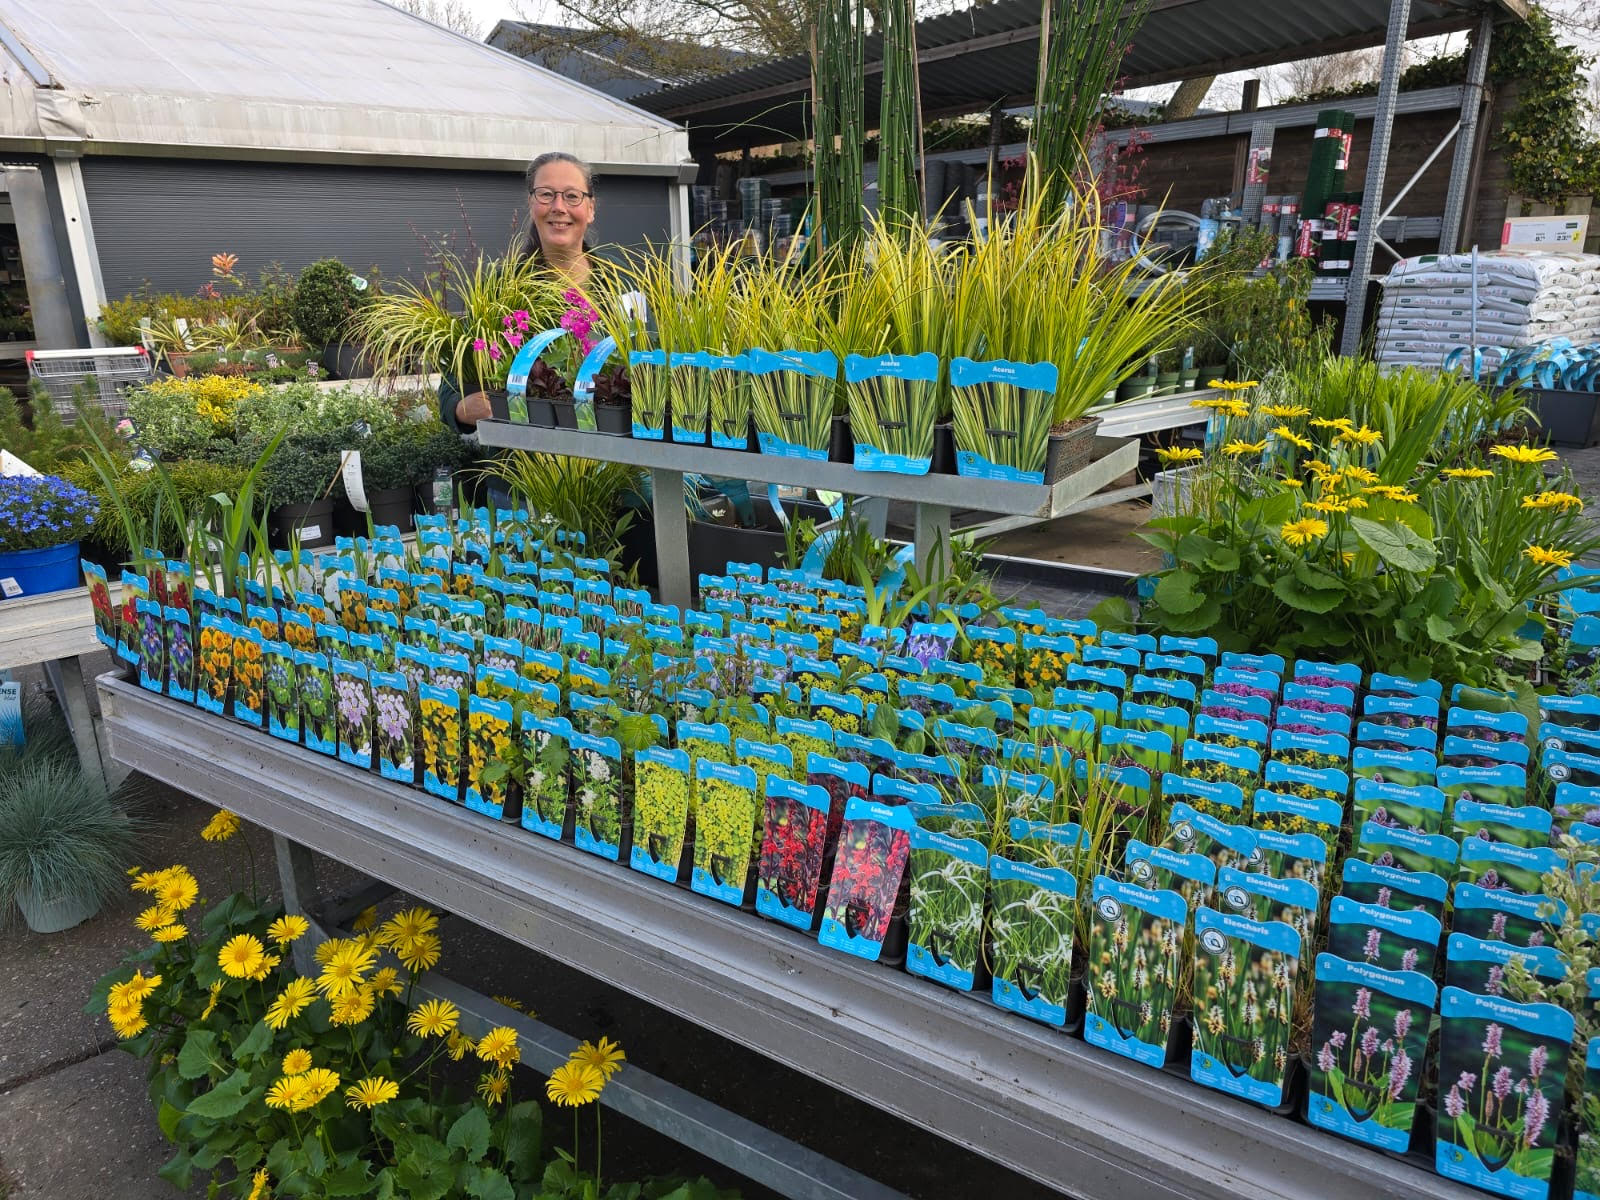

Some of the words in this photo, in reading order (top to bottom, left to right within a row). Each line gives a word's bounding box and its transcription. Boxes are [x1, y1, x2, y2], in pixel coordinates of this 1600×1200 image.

[992, 365, 1016, 374] Acorus
[1213, 720, 1248, 731] Ranunculus
[1291, 735, 1328, 745] Ranunculus
[1383, 729, 1410, 738] Stachys
[1203, 746, 1240, 758] Ranunculus
[1472, 743, 1500, 752] Stachys
[1374, 752, 1414, 762] Pontederia
[712, 765, 740, 776] Lysimachia
[1286, 767, 1328, 780] Ranunculus
[1459, 770, 1501, 778] Pontederia
[787, 784, 808, 796] Lobelia
[896, 783, 918, 794] Lobelia
[1182, 781, 1222, 794] Ranunculus
[1378, 784, 1421, 797] Pontederia
[1276, 796, 1320, 811] Ranunculus
[870, 805, 893, 817] Lobelia
[1480, 806, 1525, 819] Pontederia
[1196, 816, 1233, 837] Eleocharis
[929, 835, 969, 852] Dichromena
[1259, 832, 1300, 847] Eleocharis
[1386, 830, 1432, 846] Pontederia
[1151, 849, 1190, 867] Eleocharis
[1489, 845, 1538, 860] Pontederia
[1011, 864, 1055, 881] Dichromena
[1370, 868, 1421, 884] Polygonum
[1246, 876, 1290, 892] Eleocharis
[1118, 886, 1160, 903] Eleocharis
[1484, 892, 1538, 908] Polygonum
[1359, 906, 1412, 925] Polygonum
[1223, 918, 1269, 935] Eleocharis
[1346, 964, 1405, 986] Polygonum
[1475, 998, 1540, 1020] Polygonum
